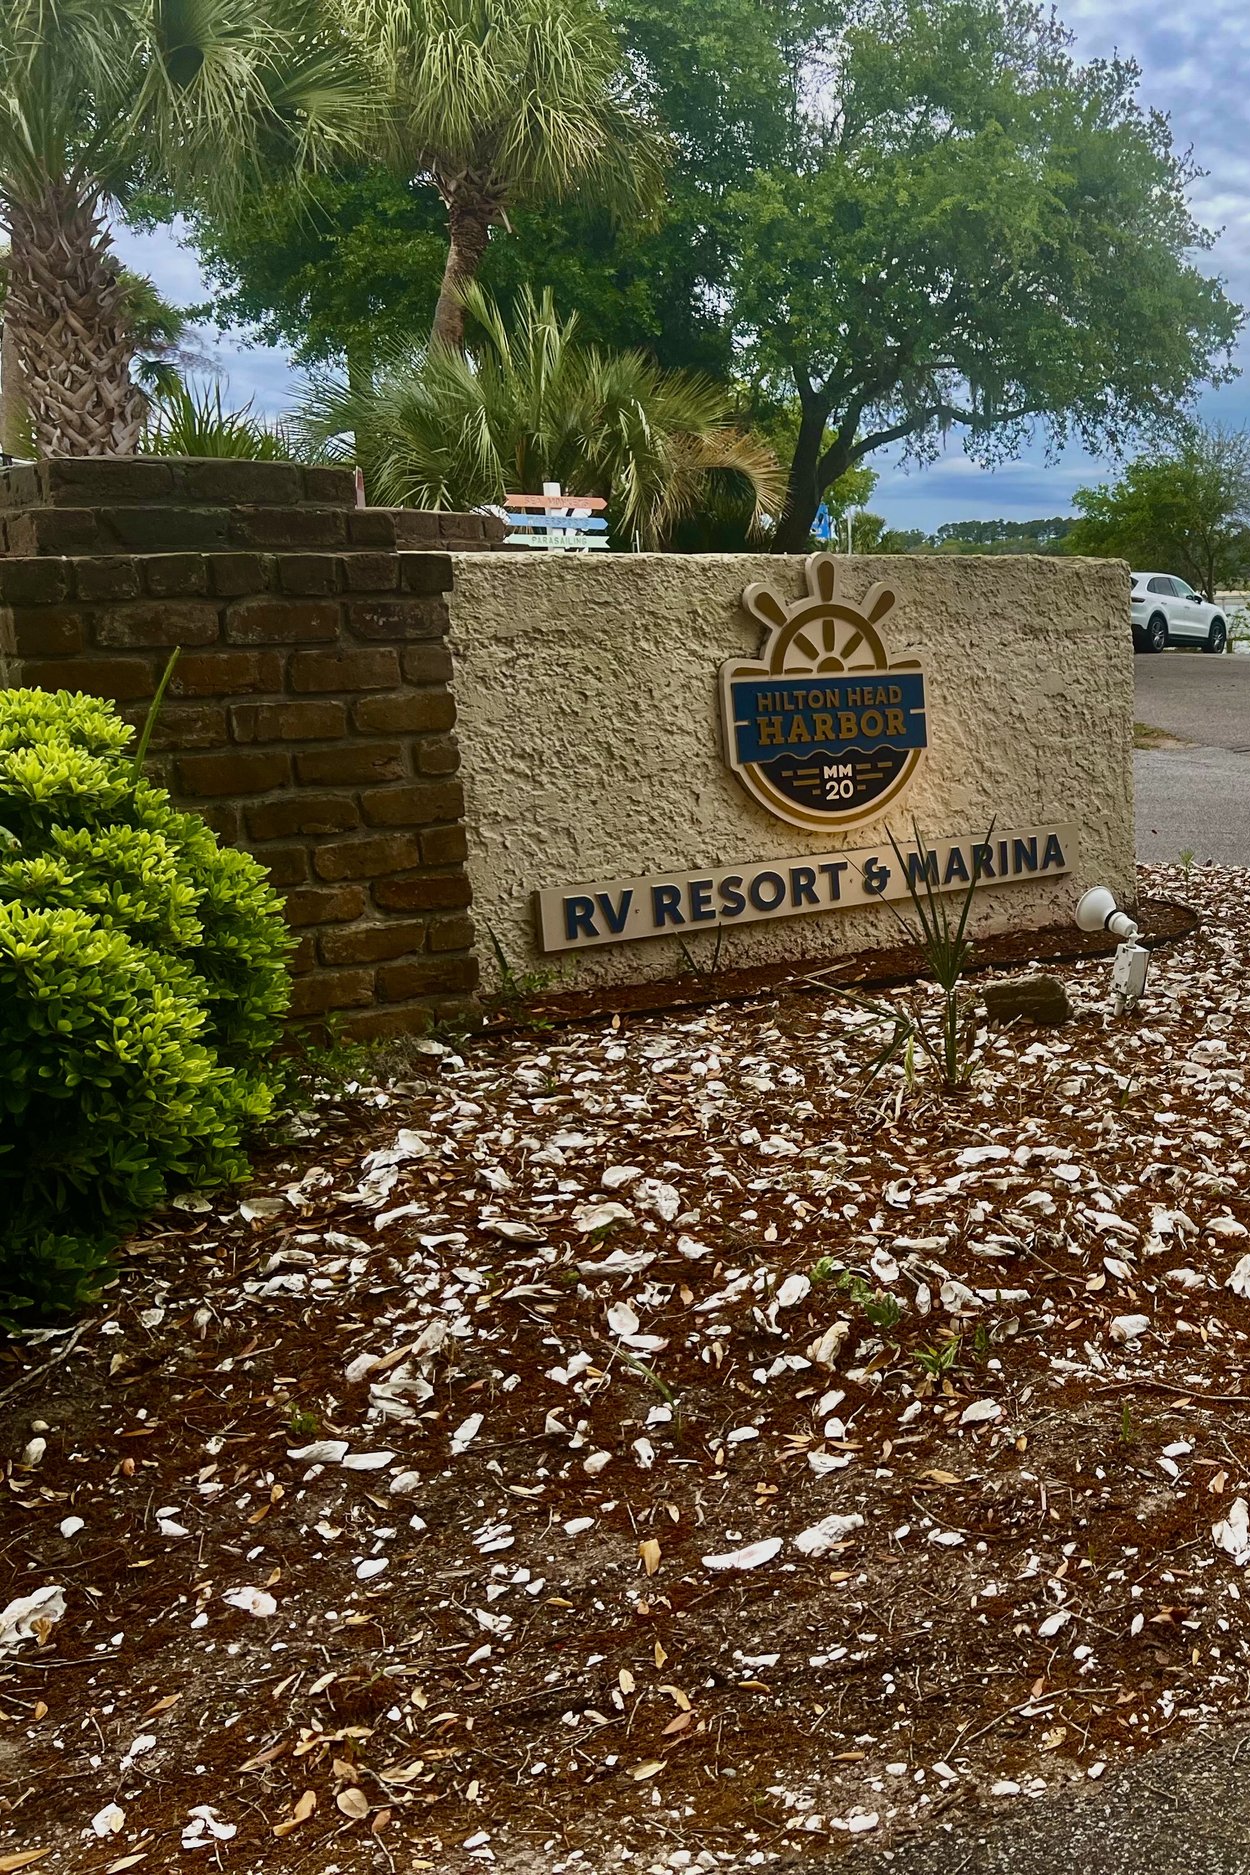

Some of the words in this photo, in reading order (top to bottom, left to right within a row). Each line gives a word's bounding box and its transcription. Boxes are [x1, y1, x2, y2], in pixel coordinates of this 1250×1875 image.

[531, 536, 588, 545] PARASAILING
[757, 688, 840, 712] HILTON
[847, 685, 903, 706] HEAD
[756, 708, 907, 745] HARBOR
[823, 763, 853, 779] MM
[825, 779, 854, 800] 20
[563, 887, 634, 940] RV
[651, 860, 849, 927] RESORT
[862, 856, 891, 895] &
[906, 832, 1066, 891] MARINA
